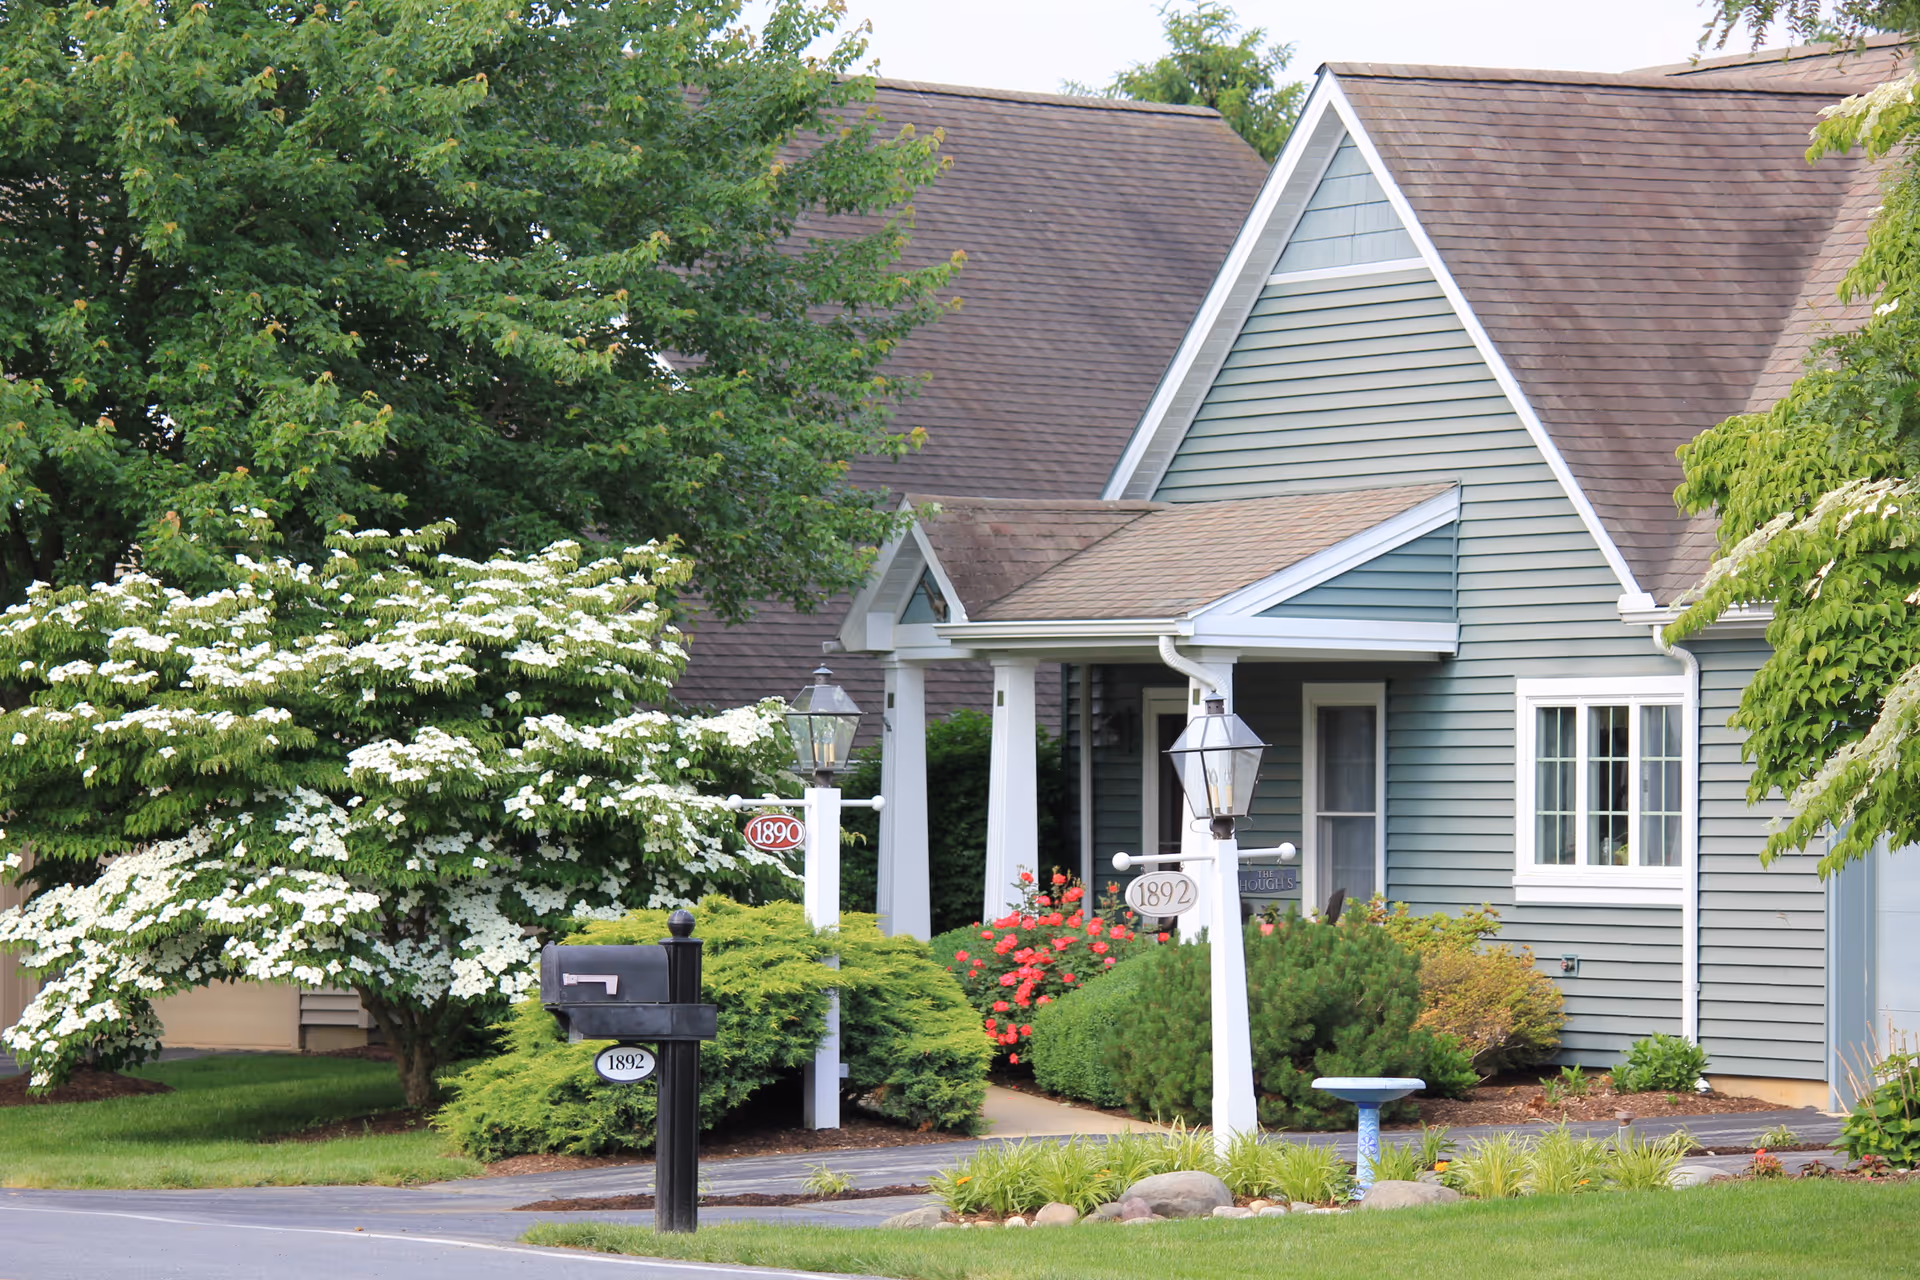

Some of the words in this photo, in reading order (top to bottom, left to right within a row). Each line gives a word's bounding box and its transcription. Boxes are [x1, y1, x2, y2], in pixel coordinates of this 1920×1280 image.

[754, 821, 803, 844] 1890
[1138, 880, 1191, 907] 1892
[608, 1053, 645, 1070] 1892
